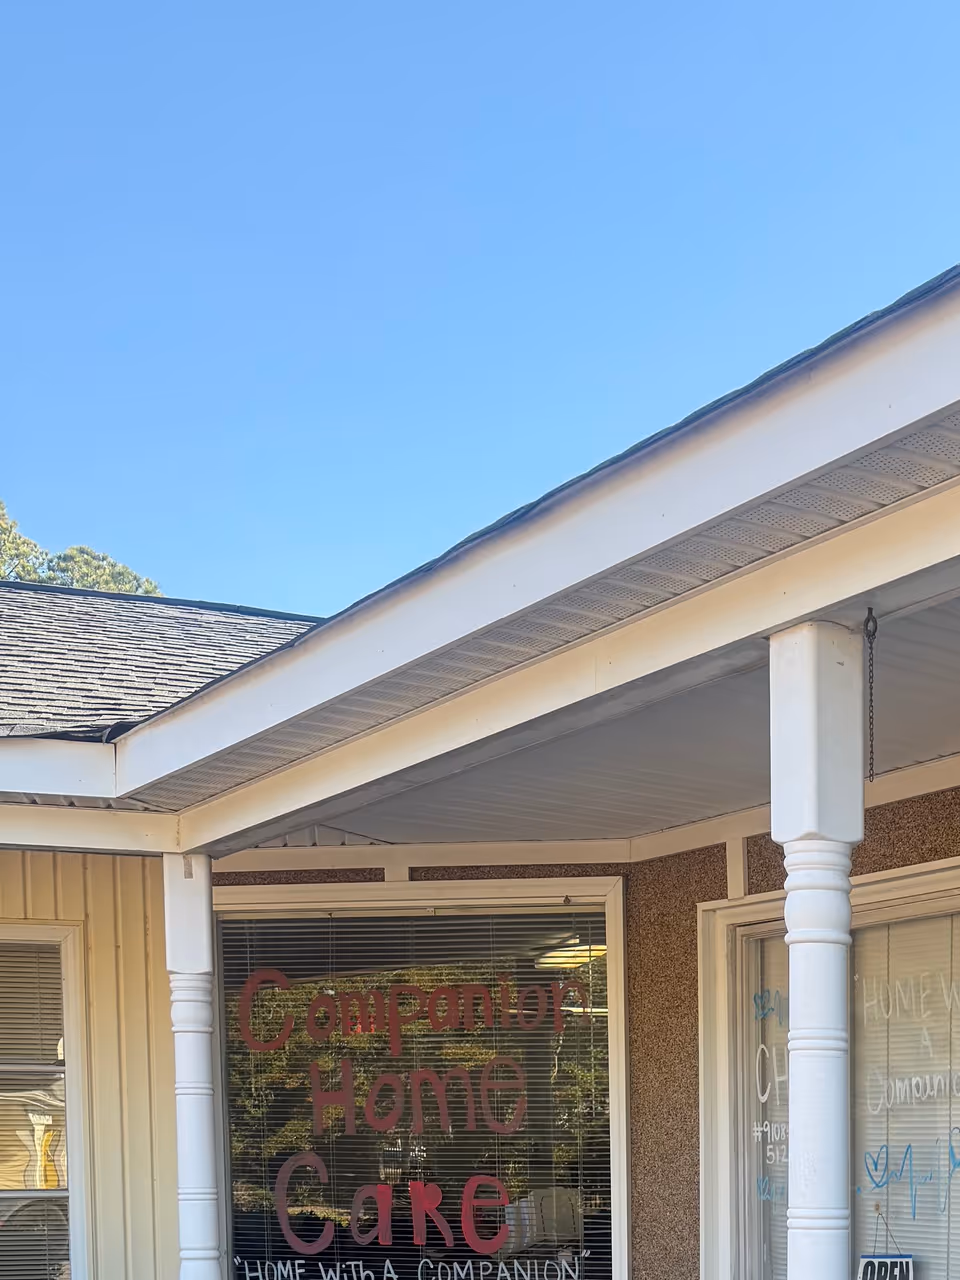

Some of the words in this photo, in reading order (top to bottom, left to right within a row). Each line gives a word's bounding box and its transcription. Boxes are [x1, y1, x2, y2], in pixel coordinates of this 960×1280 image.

[239, 968, 589, 1057] Companion
[919, 1026, 934, 1058] A
[309, 1056, 528, 1137] Home
[752, 1120, 789, 1144] #9108
